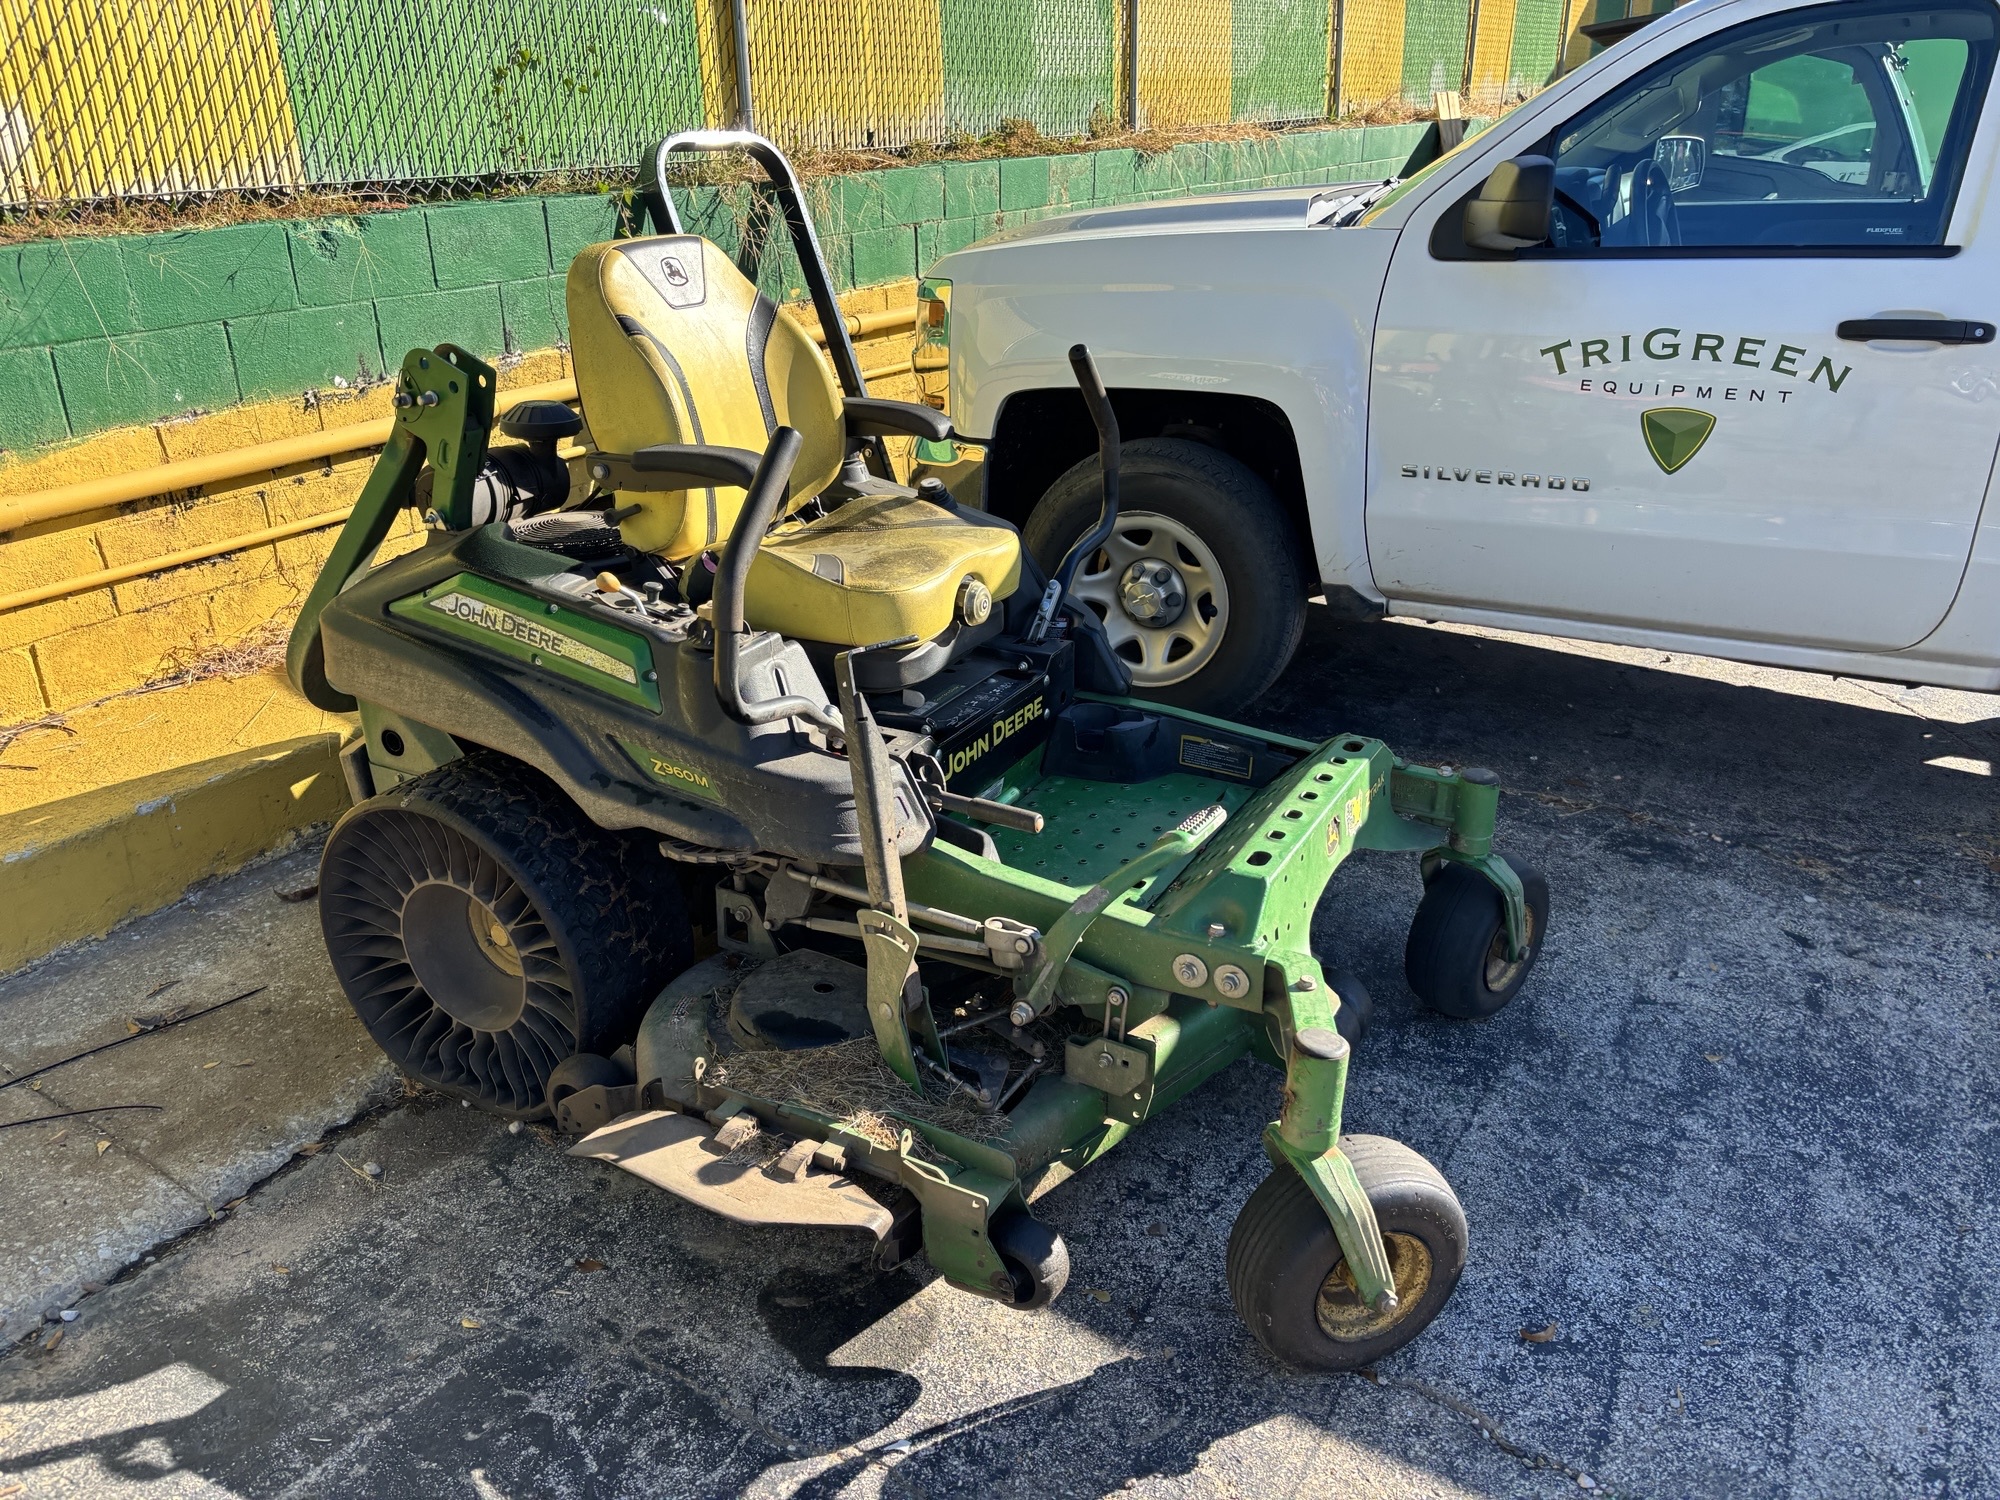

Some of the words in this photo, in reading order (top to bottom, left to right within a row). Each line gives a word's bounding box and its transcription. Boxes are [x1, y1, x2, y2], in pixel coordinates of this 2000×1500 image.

[1540, 327, 1852, 393] TRIGREEN
[1580, 378, 1793, 403] EQUIPMENT
[1401, 463, 1591, 492] SILVERADO
[447, 596, 498, 630] JOHN
[501, 614, 563, 655] DEERE
[944, 733, 990, 782] JOHN
[993, 695, 1043, 747] DEERE
[650, 757, 709, 788] Z960M
